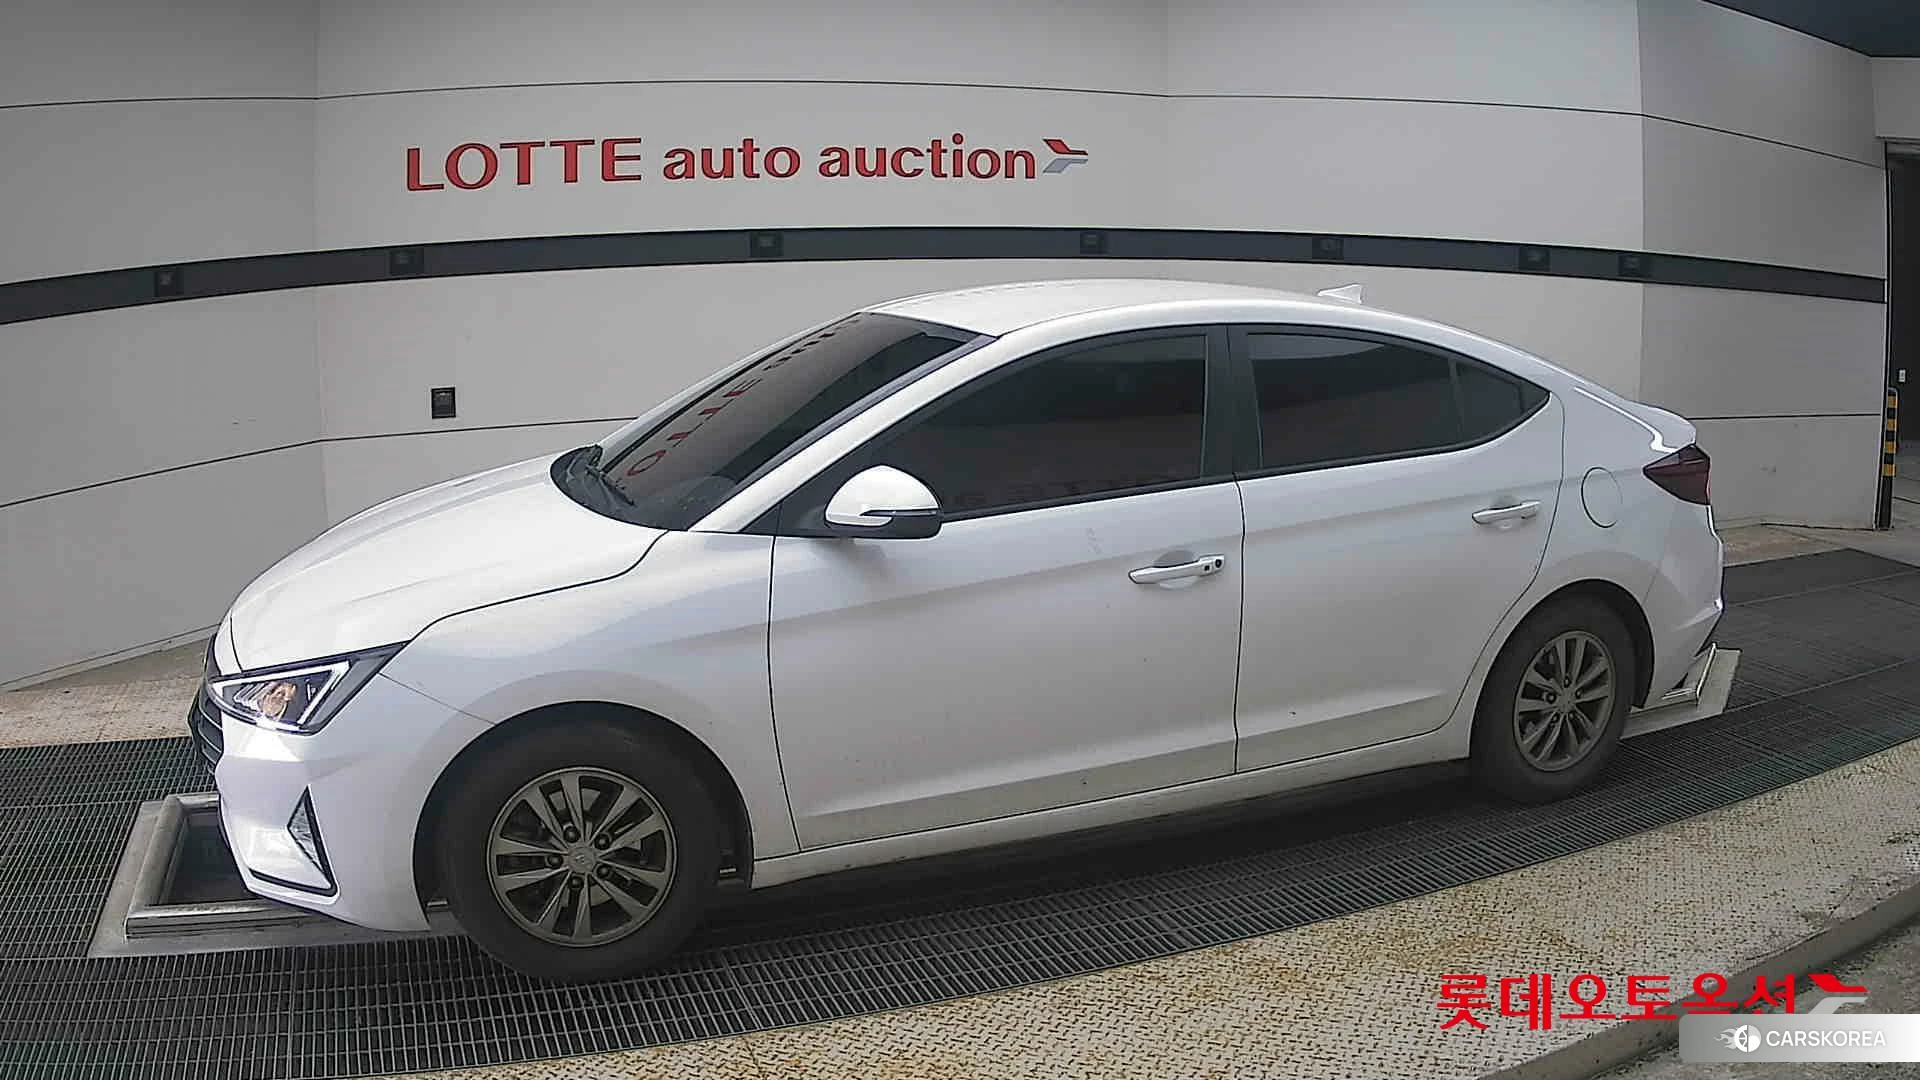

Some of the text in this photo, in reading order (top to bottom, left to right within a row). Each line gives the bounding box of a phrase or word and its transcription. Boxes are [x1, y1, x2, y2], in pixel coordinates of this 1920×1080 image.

[406, 132, 1036, 191] LOTTE auto auction
